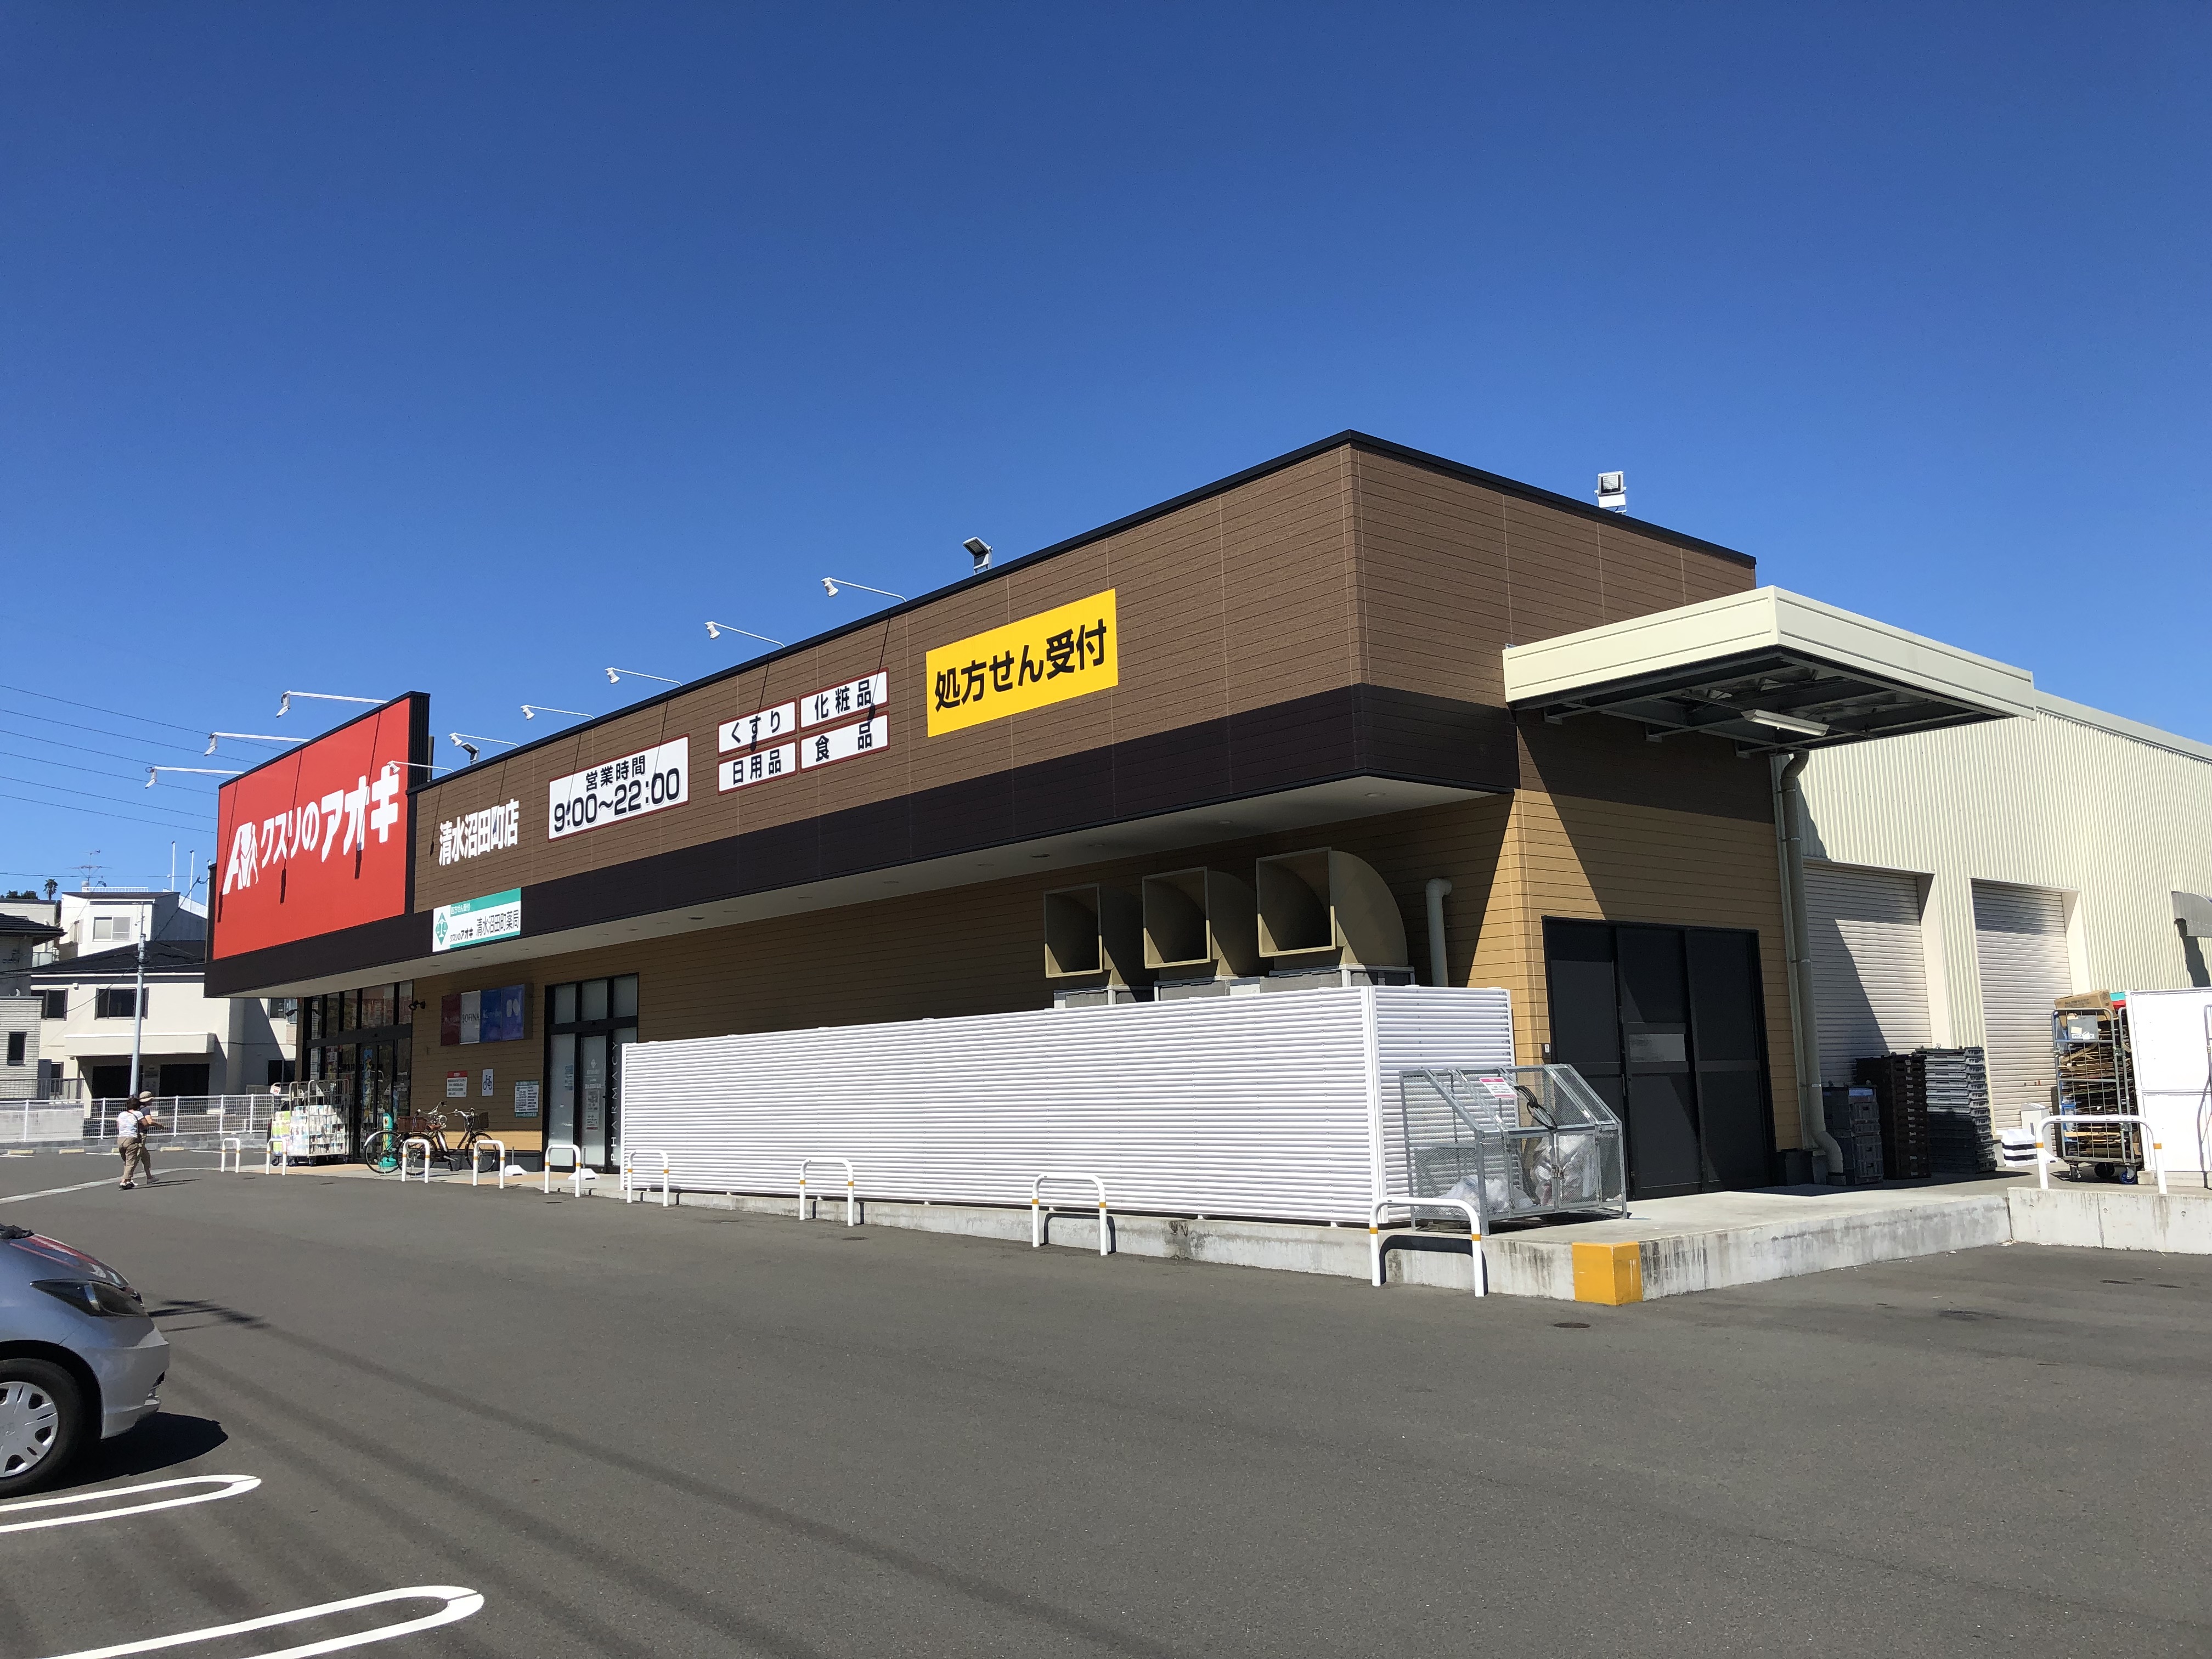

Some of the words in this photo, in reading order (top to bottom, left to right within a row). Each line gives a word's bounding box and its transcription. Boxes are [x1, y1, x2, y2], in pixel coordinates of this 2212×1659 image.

[934, 618, 1107, 713] 処方せん受付
[814, 679, 872, 721] 化粧品
[730, 710, 781, 744] くすり
[815, 723, 872, 763] 食品
[585, 754, 646, 792] 営業時間
[732, 748, 782, 785] 日用品
[261, 765, 399, 865] クスリのアオキ
[438, 798, 520, 866] 清水沼田町店
[450, 928, 473, 942] クスリのアオキ
[476, 910, 519, 936] 清水沼田町薬局
[462, 1013, 479, 1023] SOFINA
